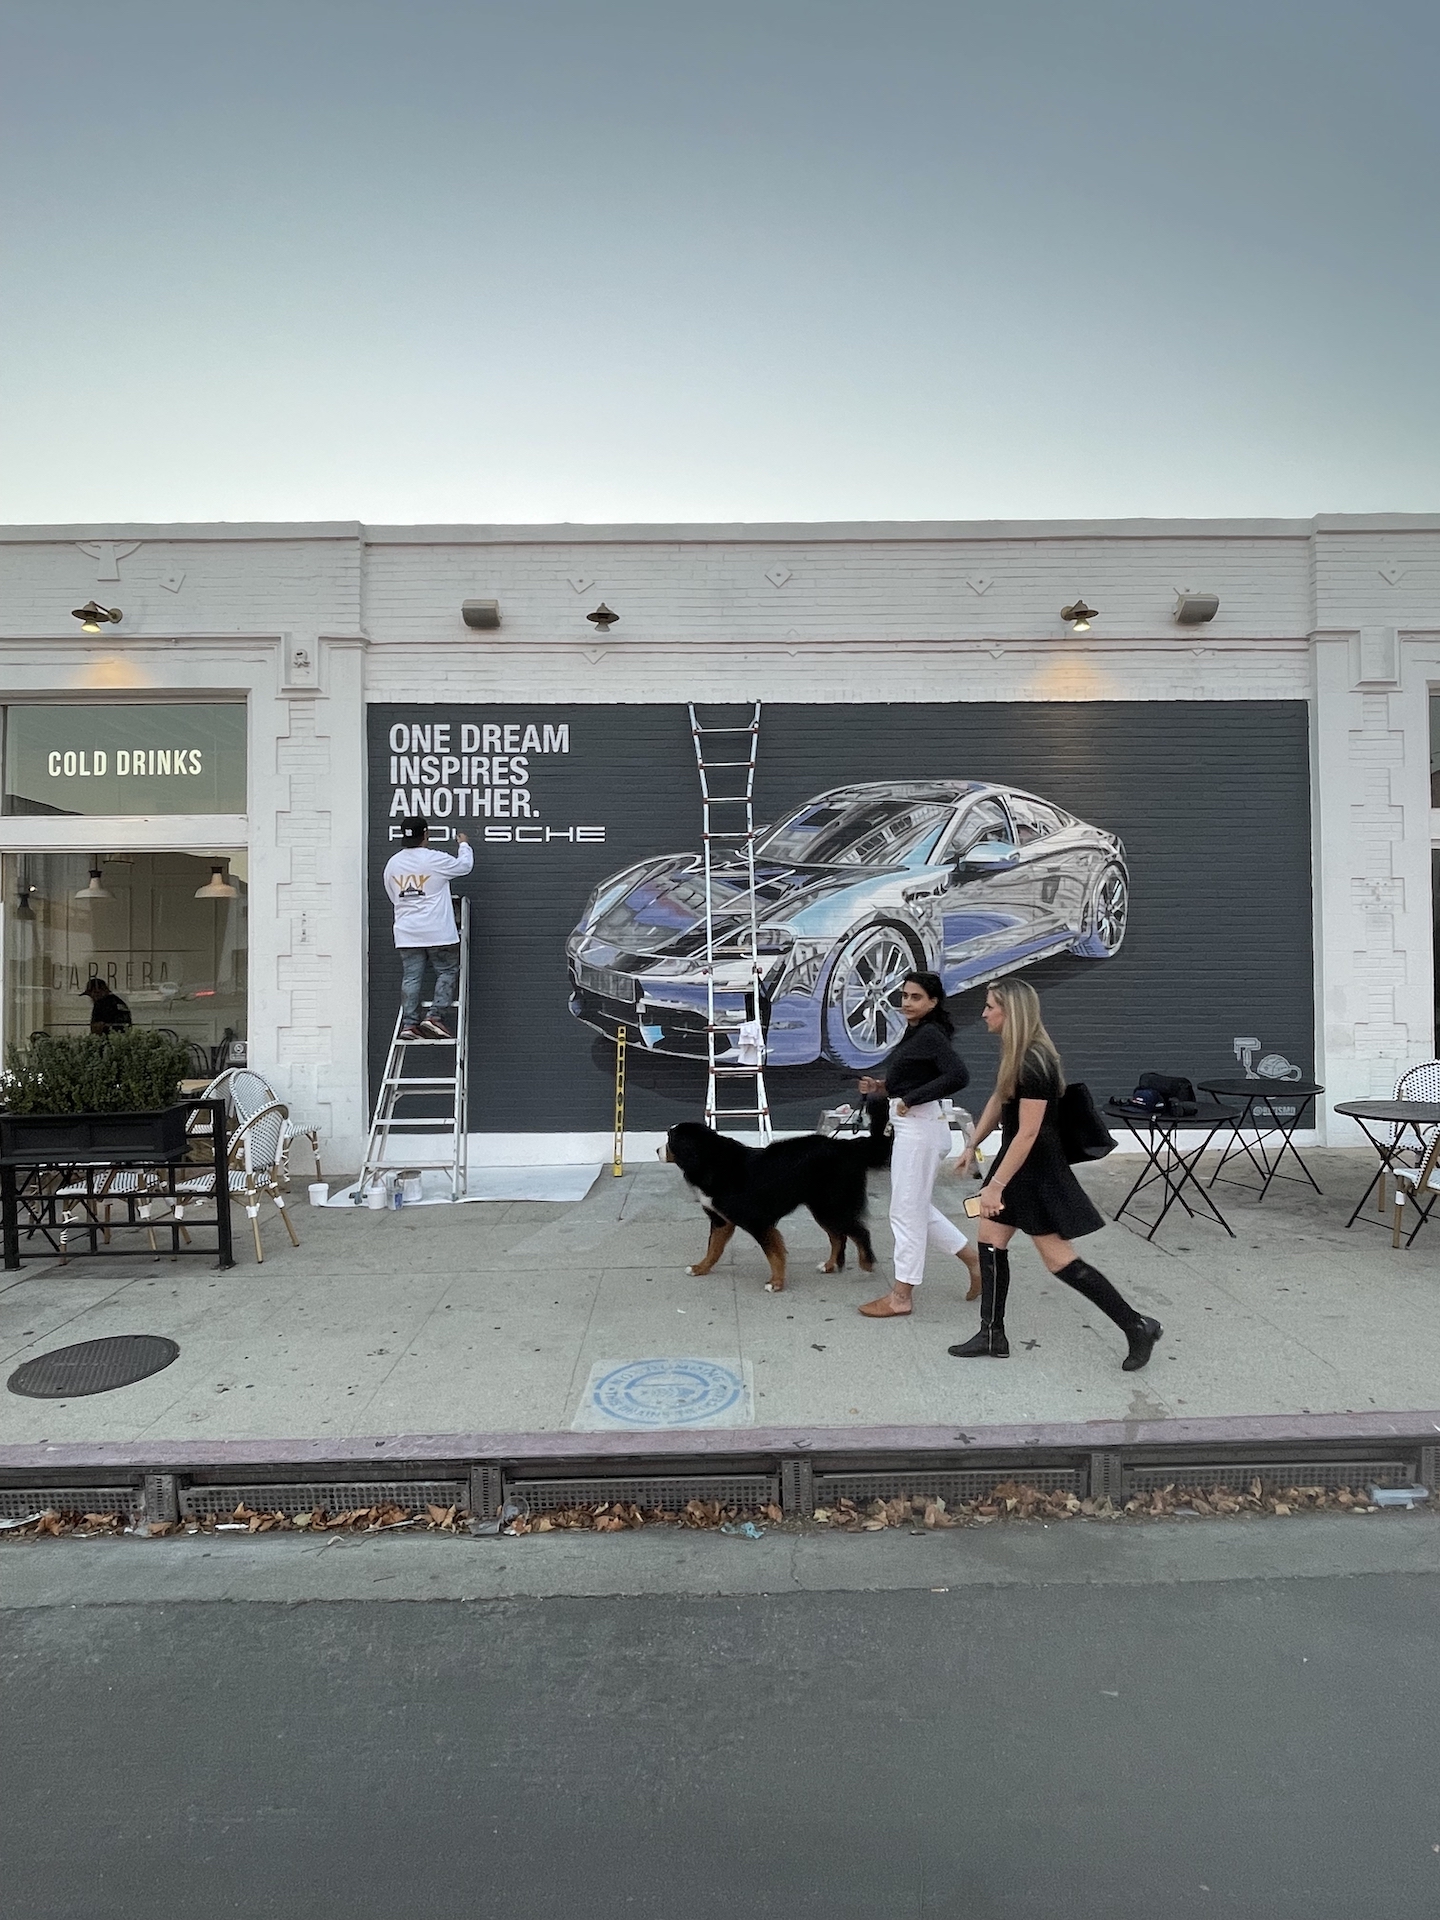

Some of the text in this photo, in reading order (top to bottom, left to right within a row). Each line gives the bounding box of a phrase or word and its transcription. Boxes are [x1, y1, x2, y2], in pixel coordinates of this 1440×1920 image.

[389, 723, 571, 754] ONE DREAM
[48, 749, 202, 777] COLD DRINKS
[389, 756, 530, 785] INSPIRES
[389, 788, 540, 818] ANOTHER.
[388, 825, 606, 843] POSCHE
